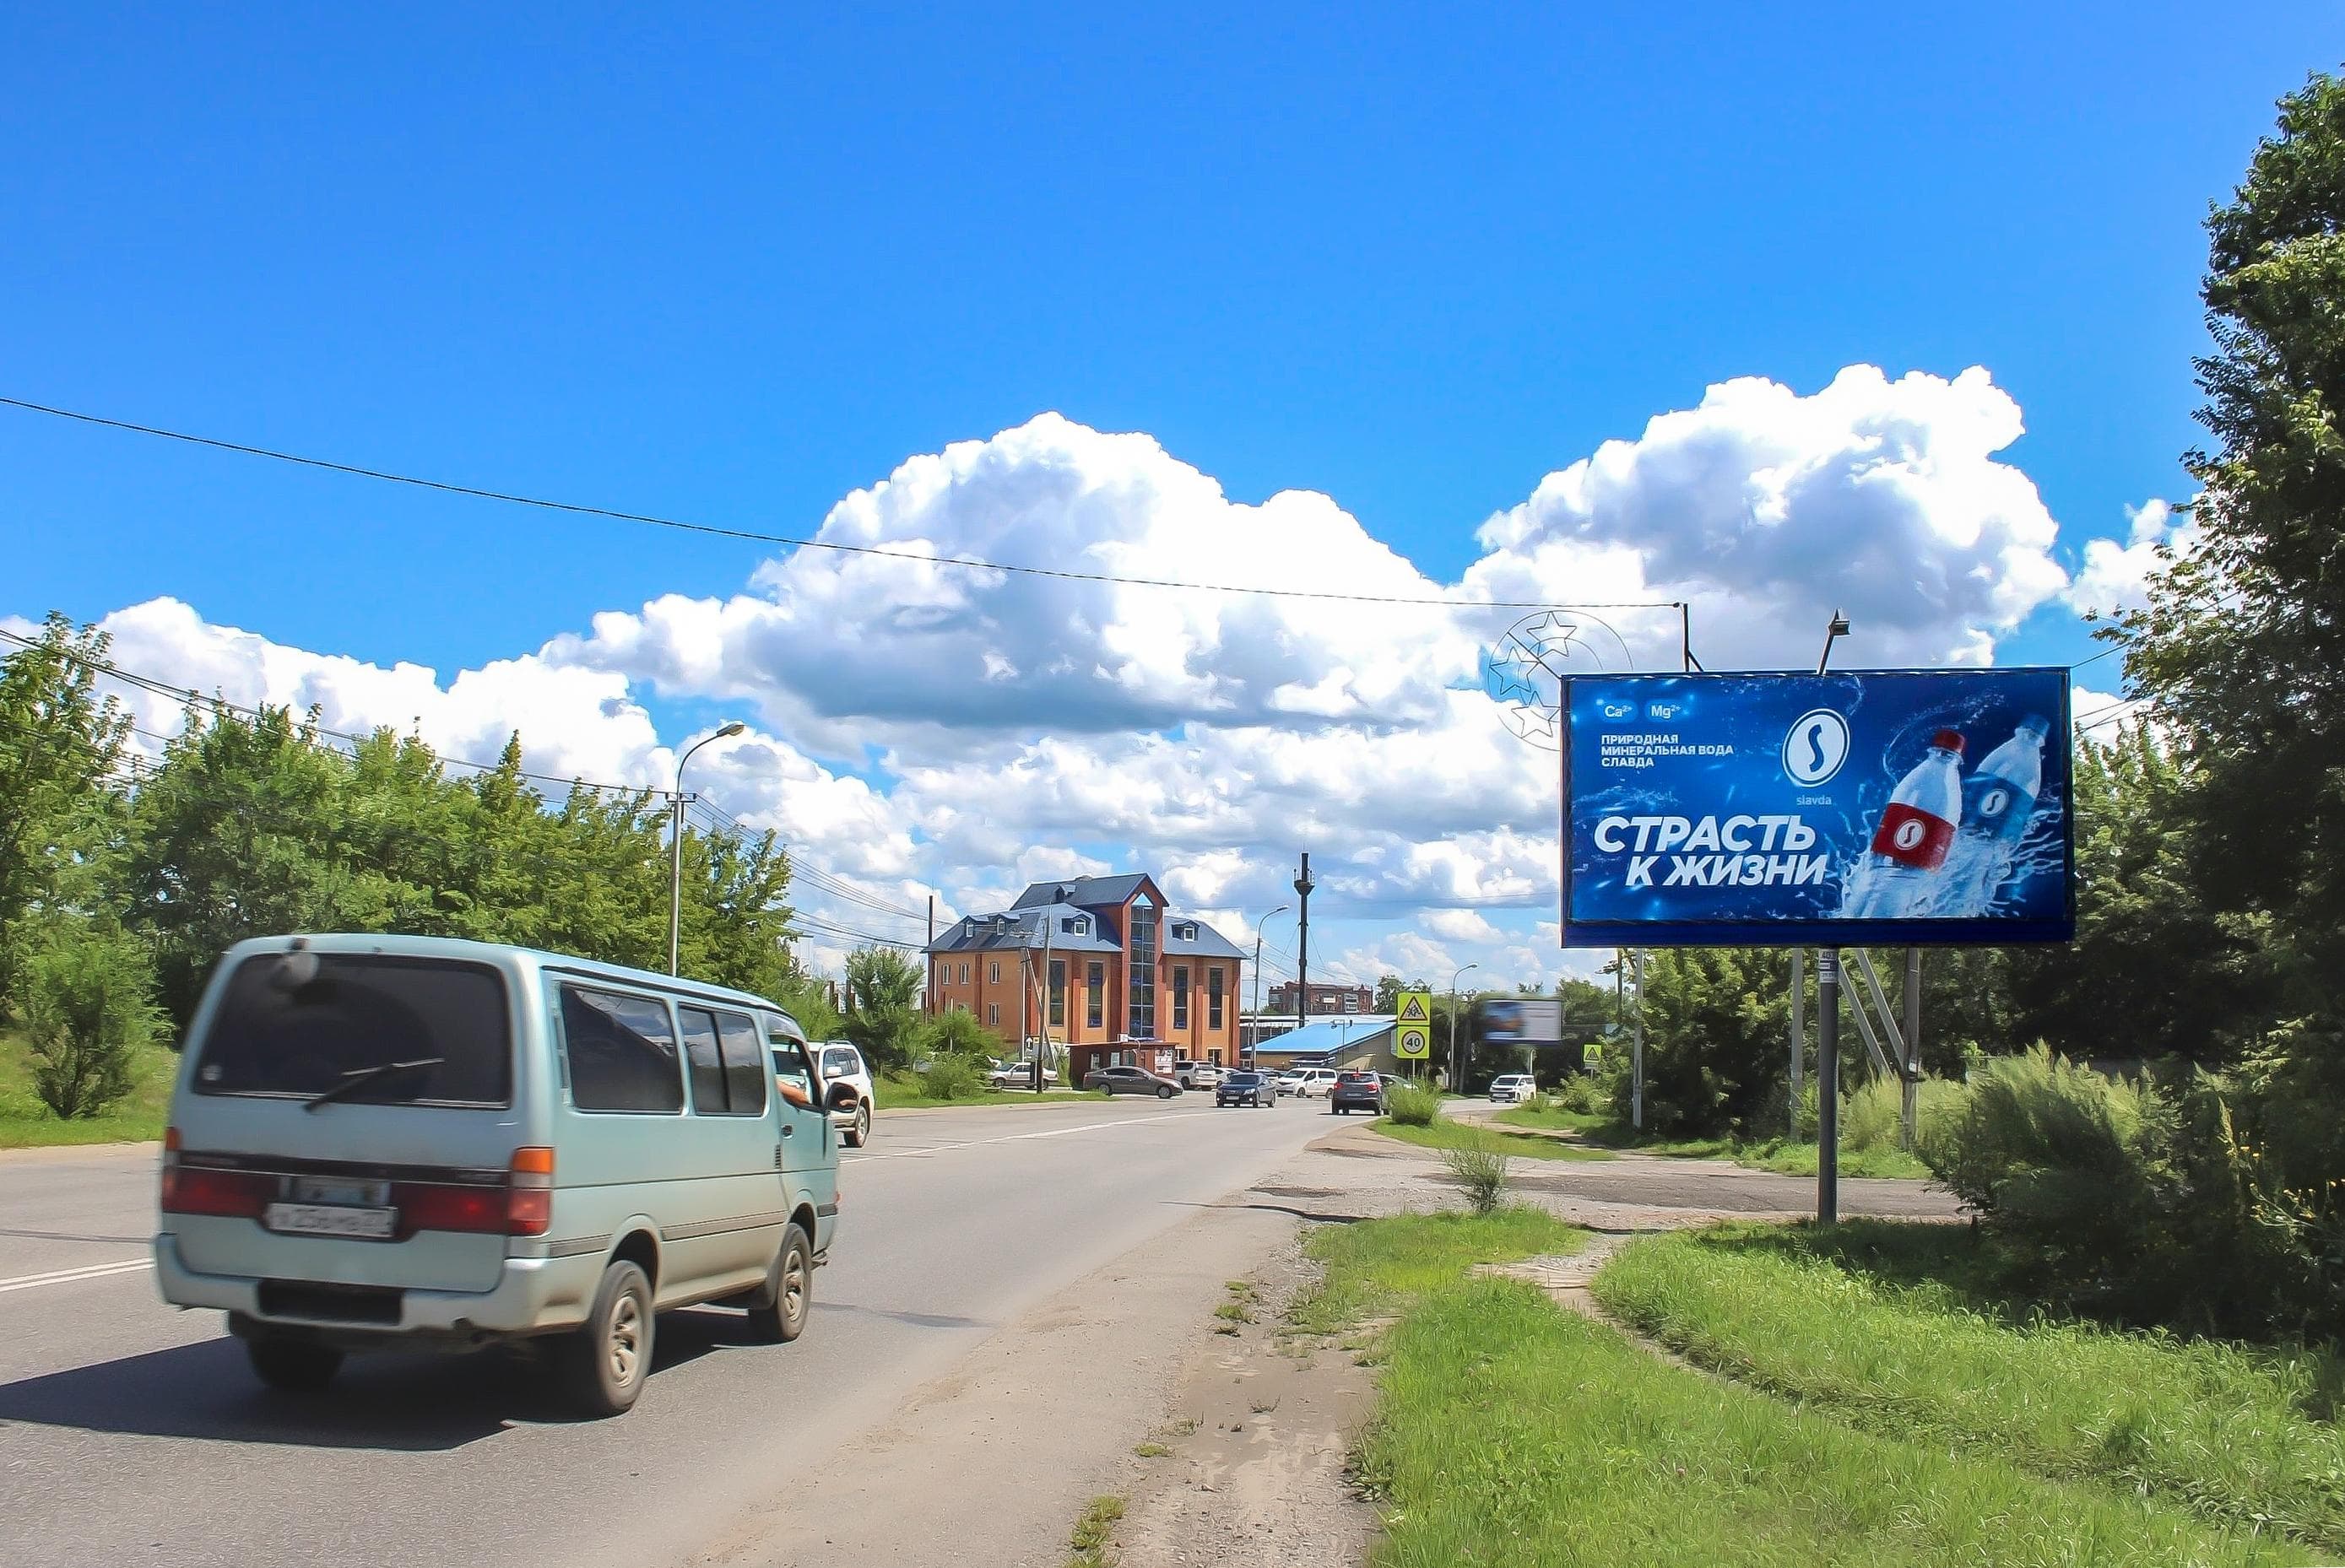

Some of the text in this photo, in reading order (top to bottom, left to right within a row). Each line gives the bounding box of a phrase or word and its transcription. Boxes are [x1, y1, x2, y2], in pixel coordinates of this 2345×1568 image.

[1601, 734, 1678, 745] ПРИРОДНАЯ
[1601, 745, 1734, 756] МИНЕРАЛЬНАЯ ВОДА
[1601, 758, 1654, 768] СЛАВДА
[1796, 795, 1832, 805] slavda
[1595, 815, 1816, 852] СТРАСТЬ
[1625, 854, 1828, 886] К ЖИЗНИ
[1406, 1037, 1421, 1047] 40
